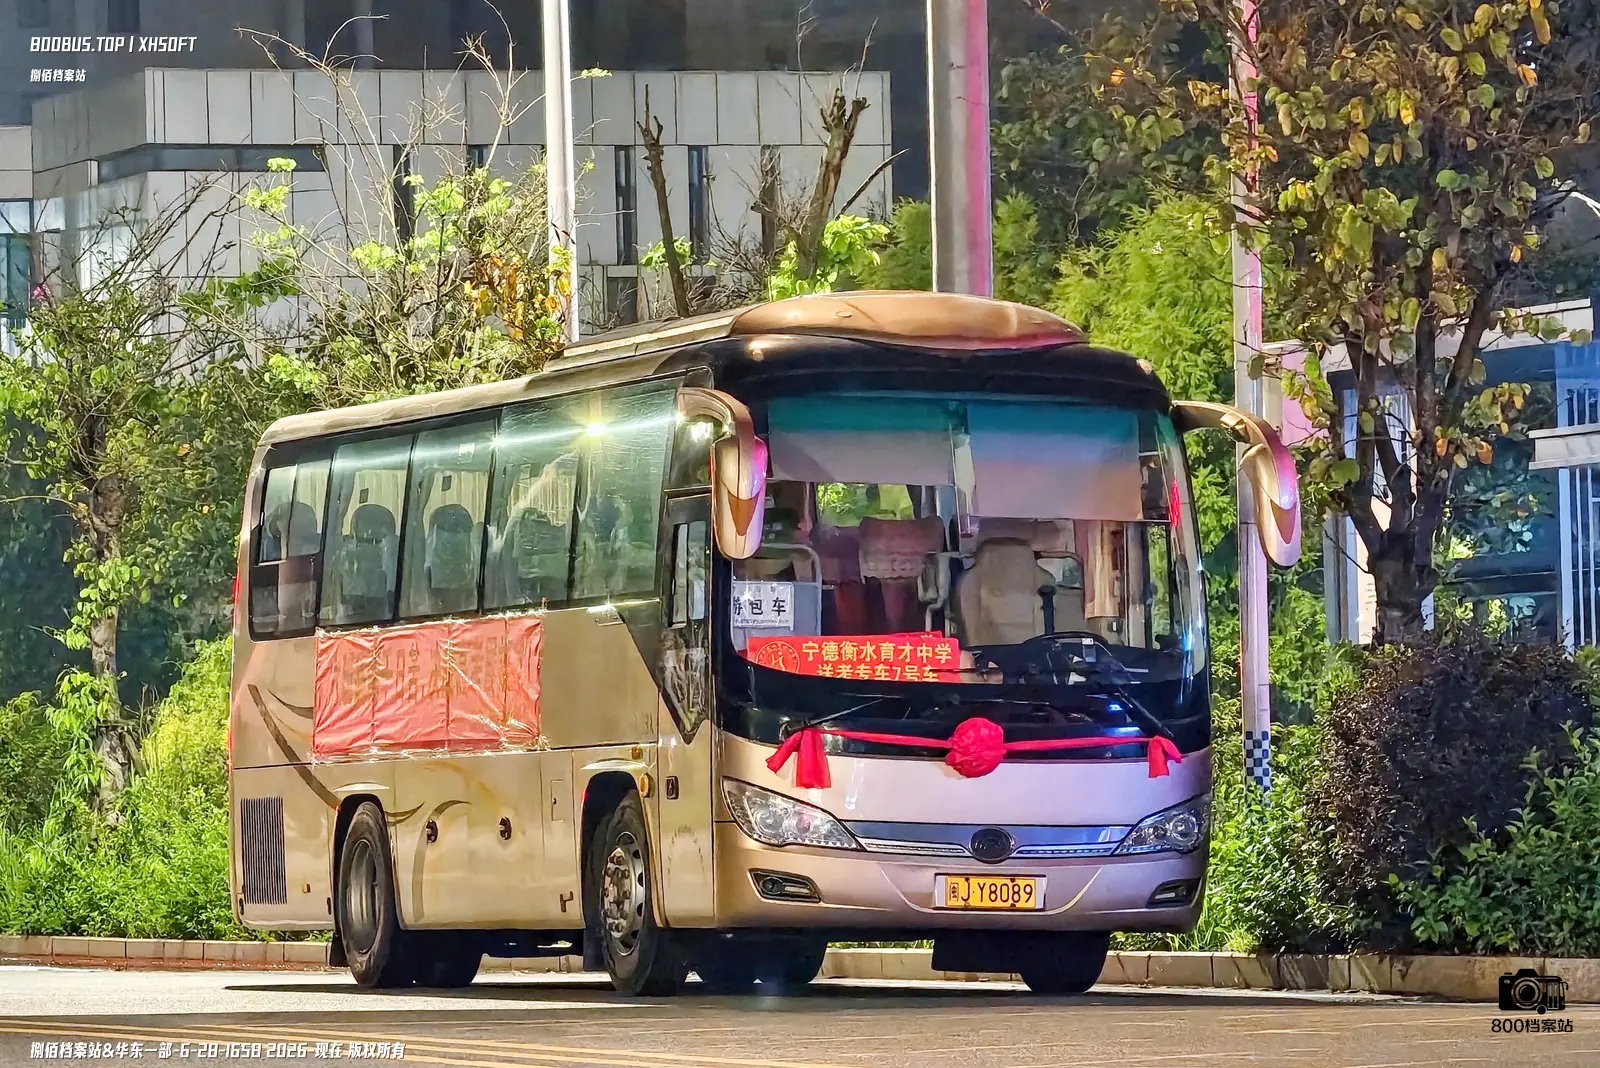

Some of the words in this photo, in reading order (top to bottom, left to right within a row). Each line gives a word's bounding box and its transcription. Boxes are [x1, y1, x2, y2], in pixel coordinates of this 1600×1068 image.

[802, 640, 953, 664] 宁德衡水育才中学
